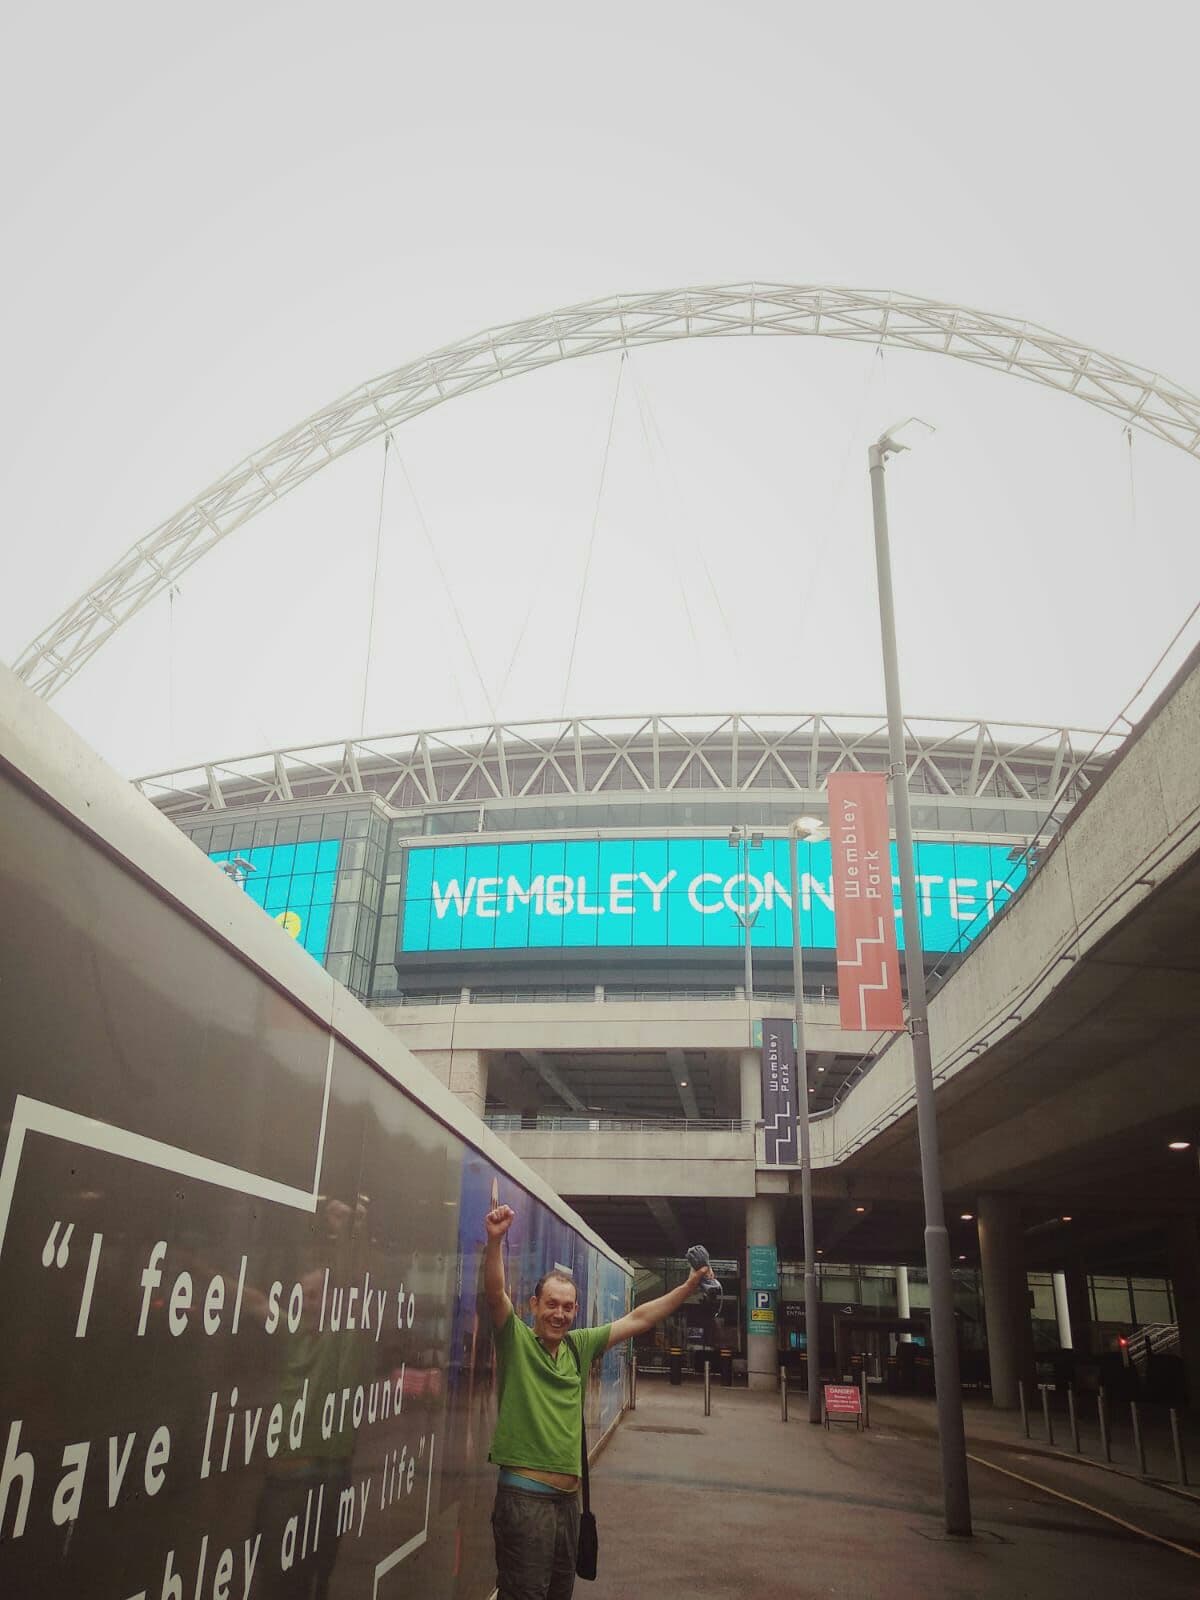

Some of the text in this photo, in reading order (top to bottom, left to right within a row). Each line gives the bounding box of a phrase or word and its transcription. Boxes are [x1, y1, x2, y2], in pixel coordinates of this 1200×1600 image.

[841, 800, 860, 898] Wembley
[864, 850, 881, 898] Park
[432, 870, 1016, 920] WEMBLEY CONNTED
[769, 1034, 779, 1091] Wembley
[780, 1063, 790, 1091] Park
[137, 1241, 248, 1336] feel
[264, 1281, 304, 1334] so
[318, 1268, 387, 1341] lucky
[397, 1283, 415, 1329] to
[757, 1293, 769, 1307] P
[0, 1362, 406, 1539] have lived around
[281, 1484, 324, 1571] all
[336, 1478, 371, 1537] my
